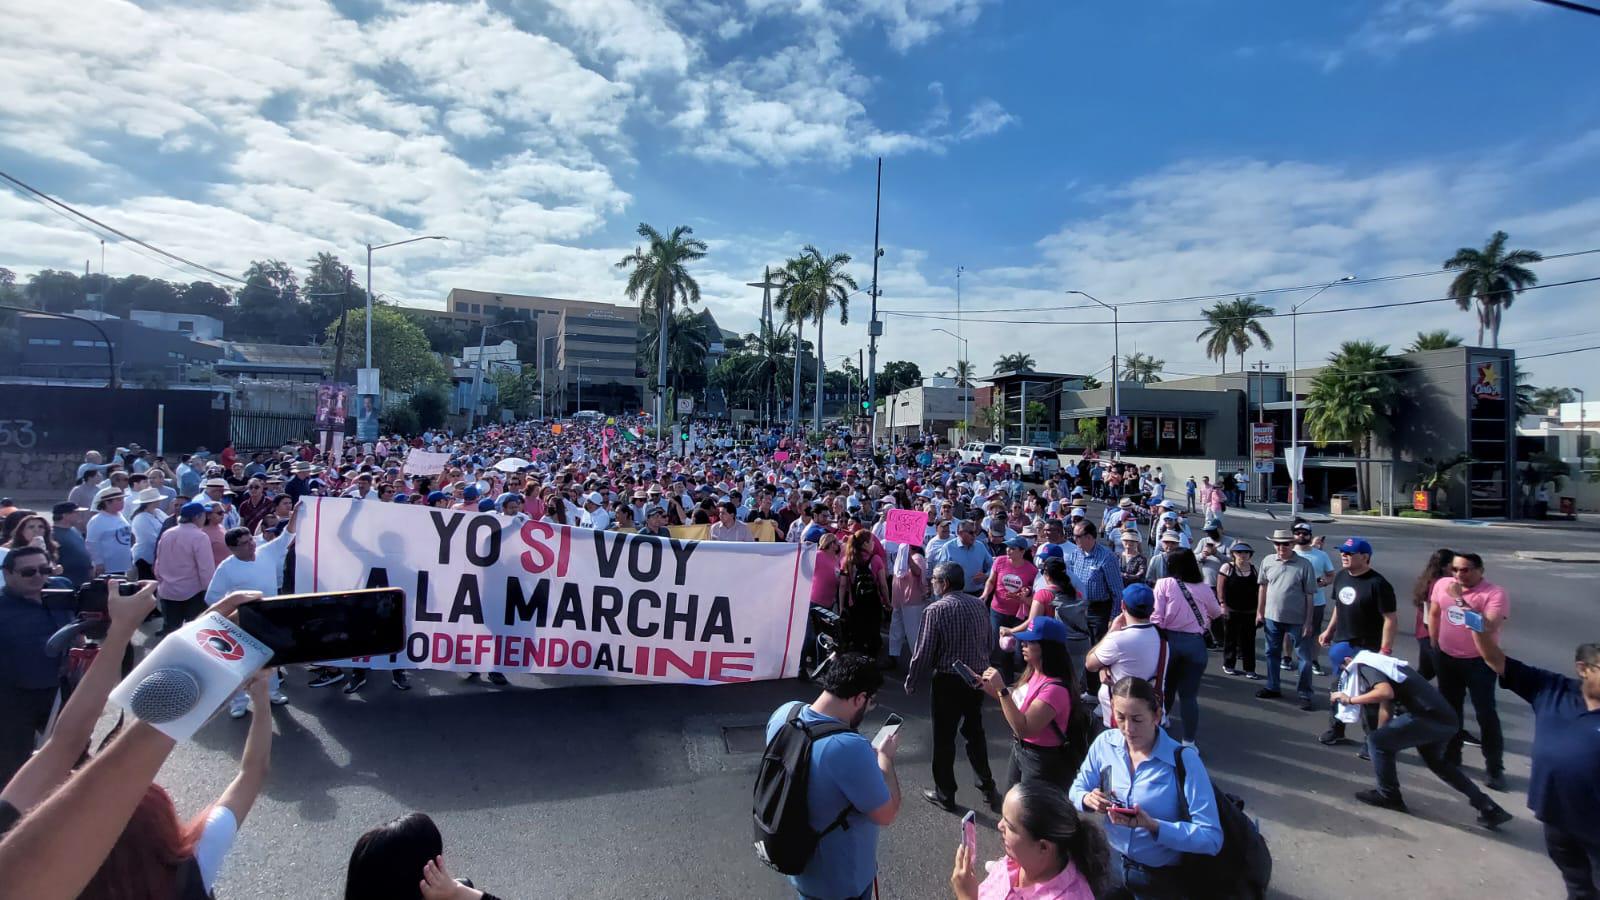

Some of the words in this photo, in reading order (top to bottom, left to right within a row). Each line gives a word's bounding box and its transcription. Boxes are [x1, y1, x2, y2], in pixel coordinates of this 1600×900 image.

[430, 511, 503, 567] YO
[520, 519, 571, 578] SI
[593, 530, 701, 585] VOY
[415, 570, 484, 624] LA
[504, 576, 752, 644] MARCHA.
[352, 631, 755, 682] ODEFIENDOALINE
